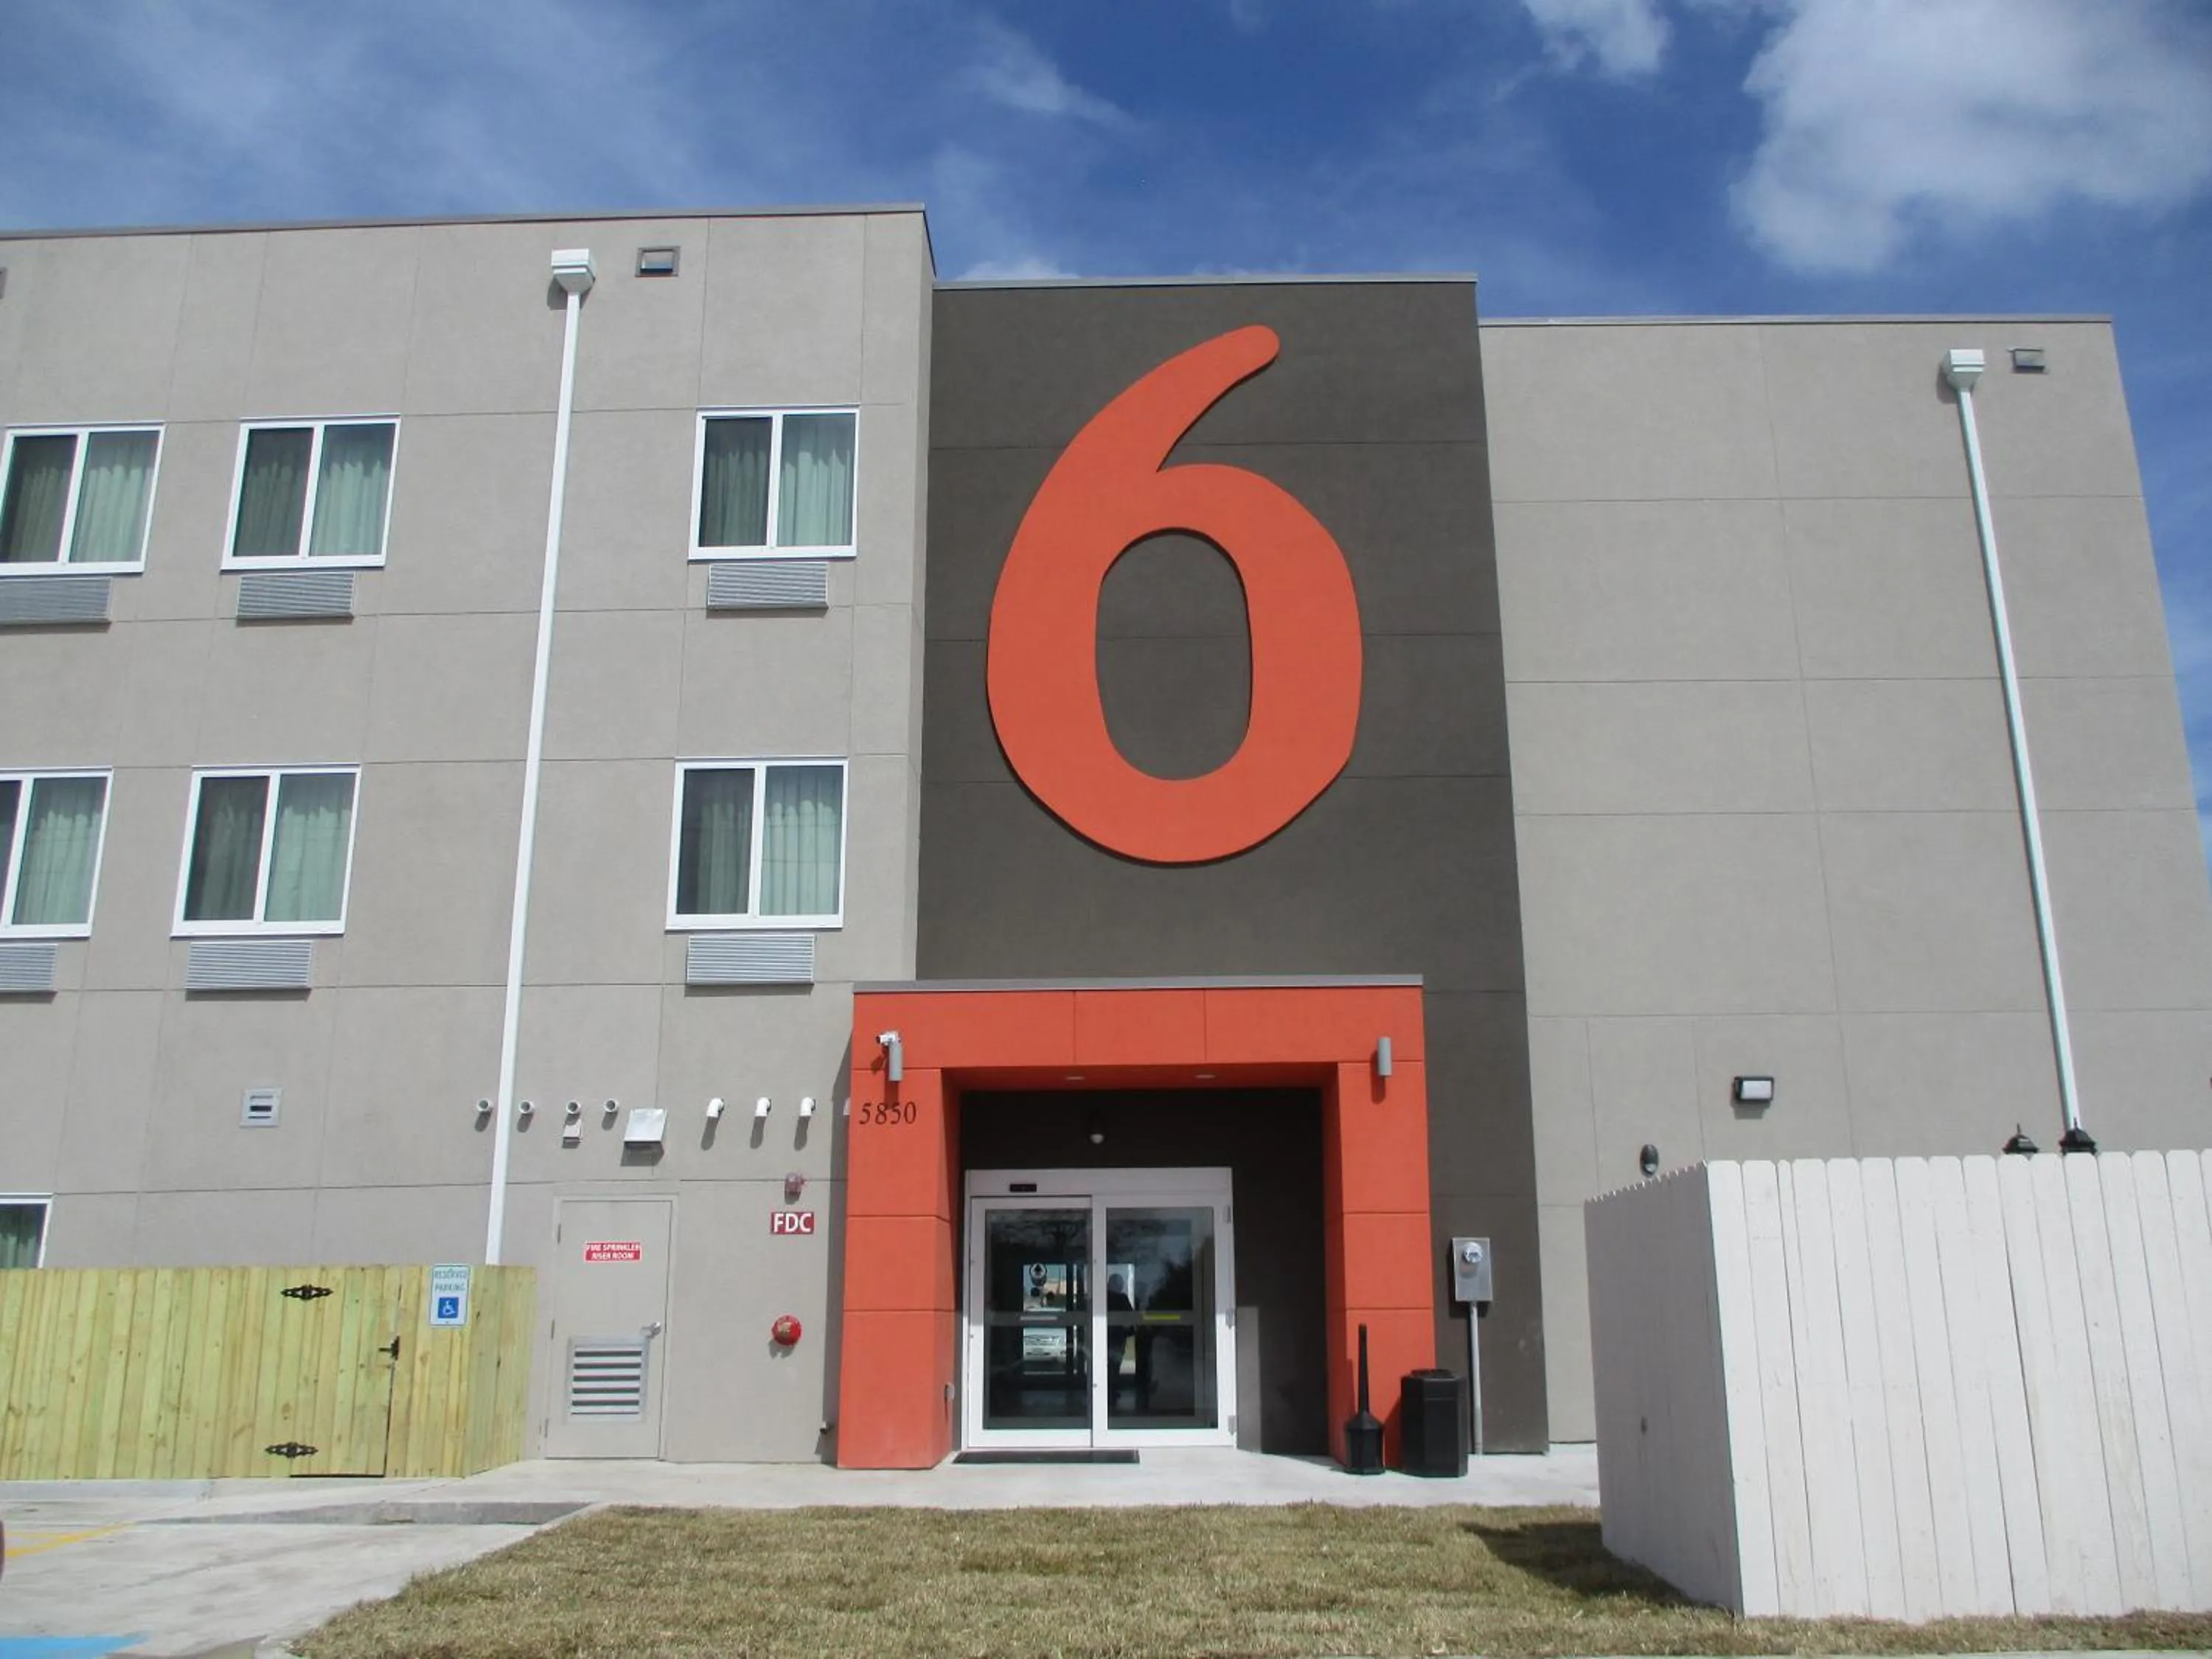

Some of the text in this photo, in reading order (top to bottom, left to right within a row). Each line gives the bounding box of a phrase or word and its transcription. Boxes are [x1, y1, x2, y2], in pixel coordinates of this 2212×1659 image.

[987, 324, 1363, 863] 6
[859, 1102, 917, 1125] 5850
[773, 1213, 812, 1232] FDC
